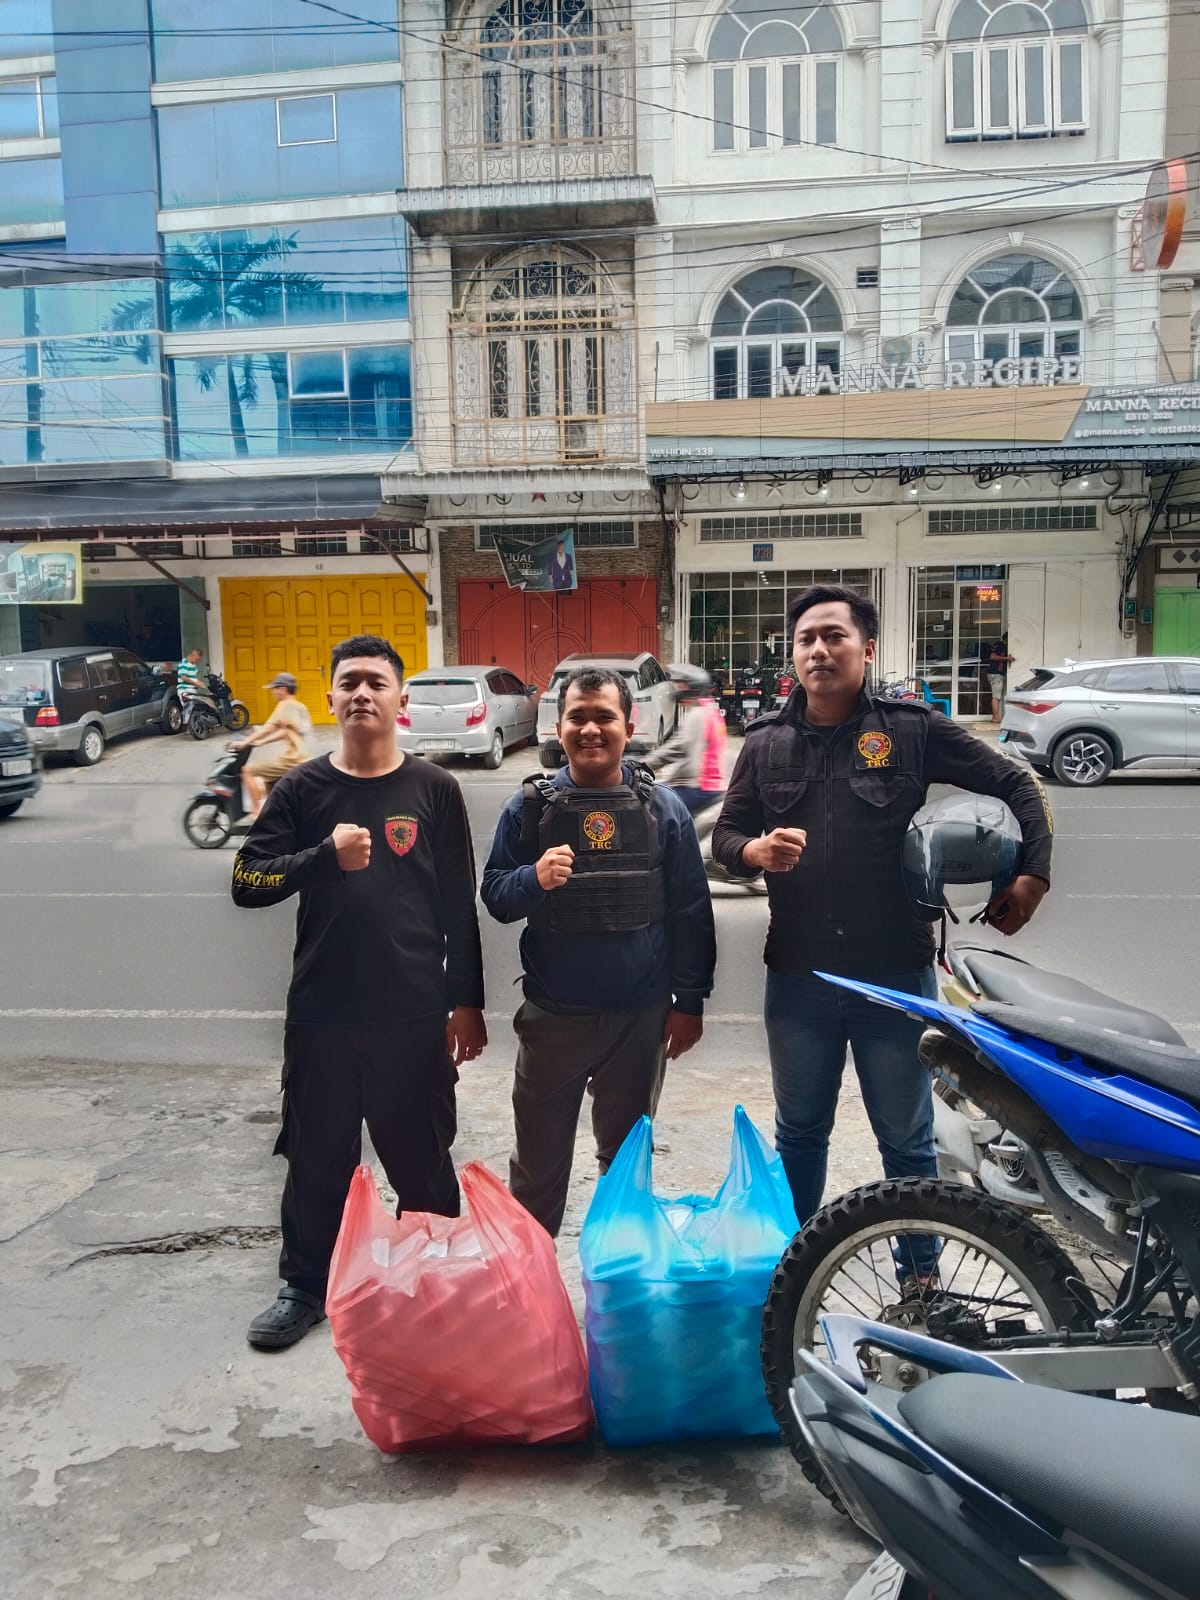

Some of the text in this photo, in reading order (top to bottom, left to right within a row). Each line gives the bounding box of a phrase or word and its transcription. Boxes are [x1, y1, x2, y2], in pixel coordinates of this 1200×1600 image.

[916, 340, 925, 364] AUX
[776, 355, 1082, 397] MANNA RECIPE
[1085, 398, 1152, 412] MANNA
[1124, 411, 1174, 421] ESTD 2020
[650, 447, 714, 457] WAHIDIN 338
[865, 759, 890, 768] TRC
[589, 841, 612, 850] TRC
